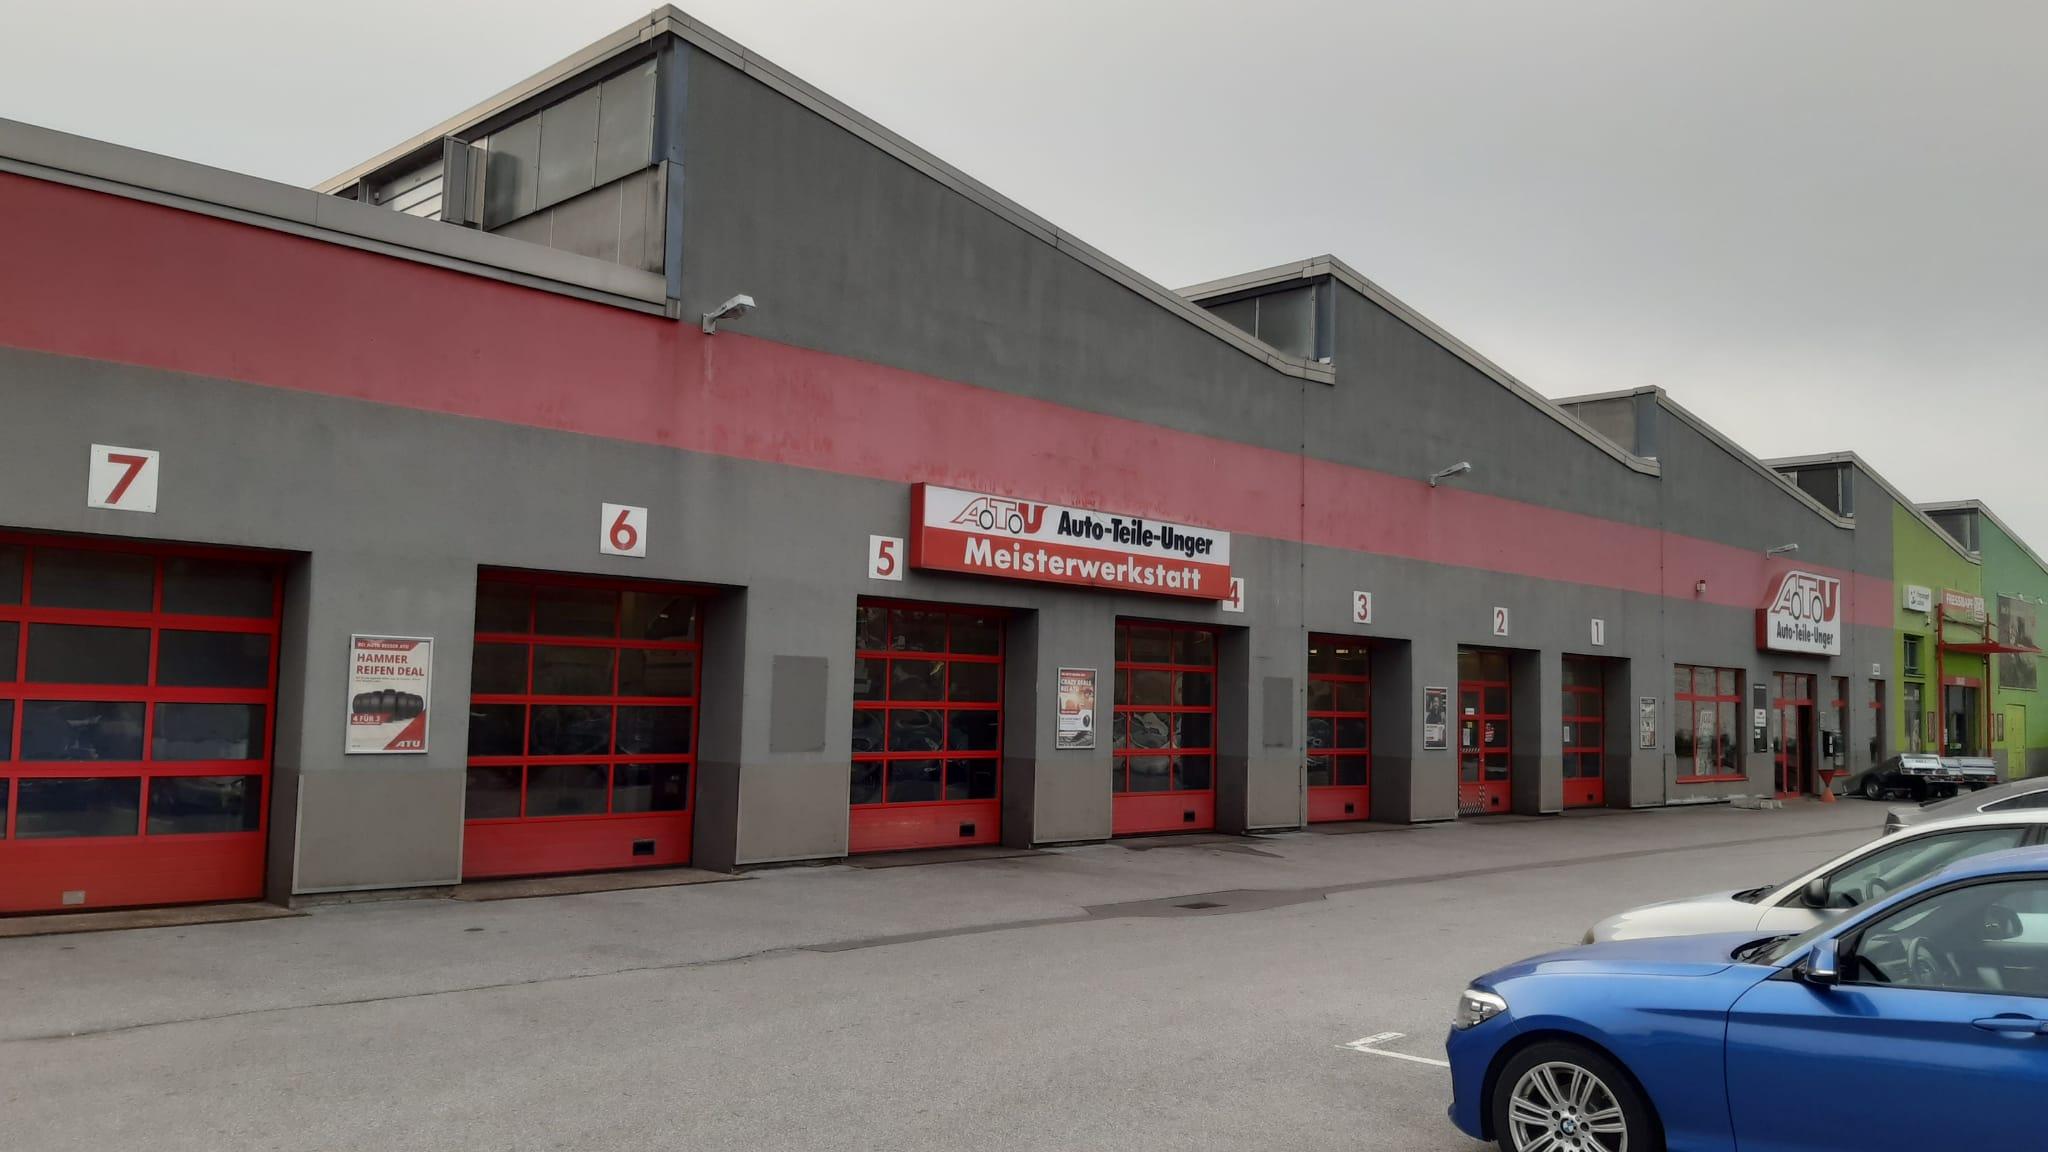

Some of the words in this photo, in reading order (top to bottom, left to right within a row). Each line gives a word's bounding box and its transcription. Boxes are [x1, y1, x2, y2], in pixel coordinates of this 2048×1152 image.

[104, 453, 149, 505] 7
[609, 509, 638, 551] 6
[1057, 510, 1213, 557] Auto-Teile-Unger
[876, 540, 895, 577] 5
[963, 536, 1201, 591] Meisterwerkstatt
[1229, 580, 1240, 609] 4
[1357, 594, 1368, 621] 3
[1496, 609, 1505, 634] 2
[1594, 621, 1600, 644] 1
[1776, 620, 1834, 649] Auto-Teile-Unger
[356, 665, 395, 676] REIFEN
[397, 667, 425, 677] DEAL
[357, 653, 408, 664] HAMMER
[395, 740, 421, 748] ATU
